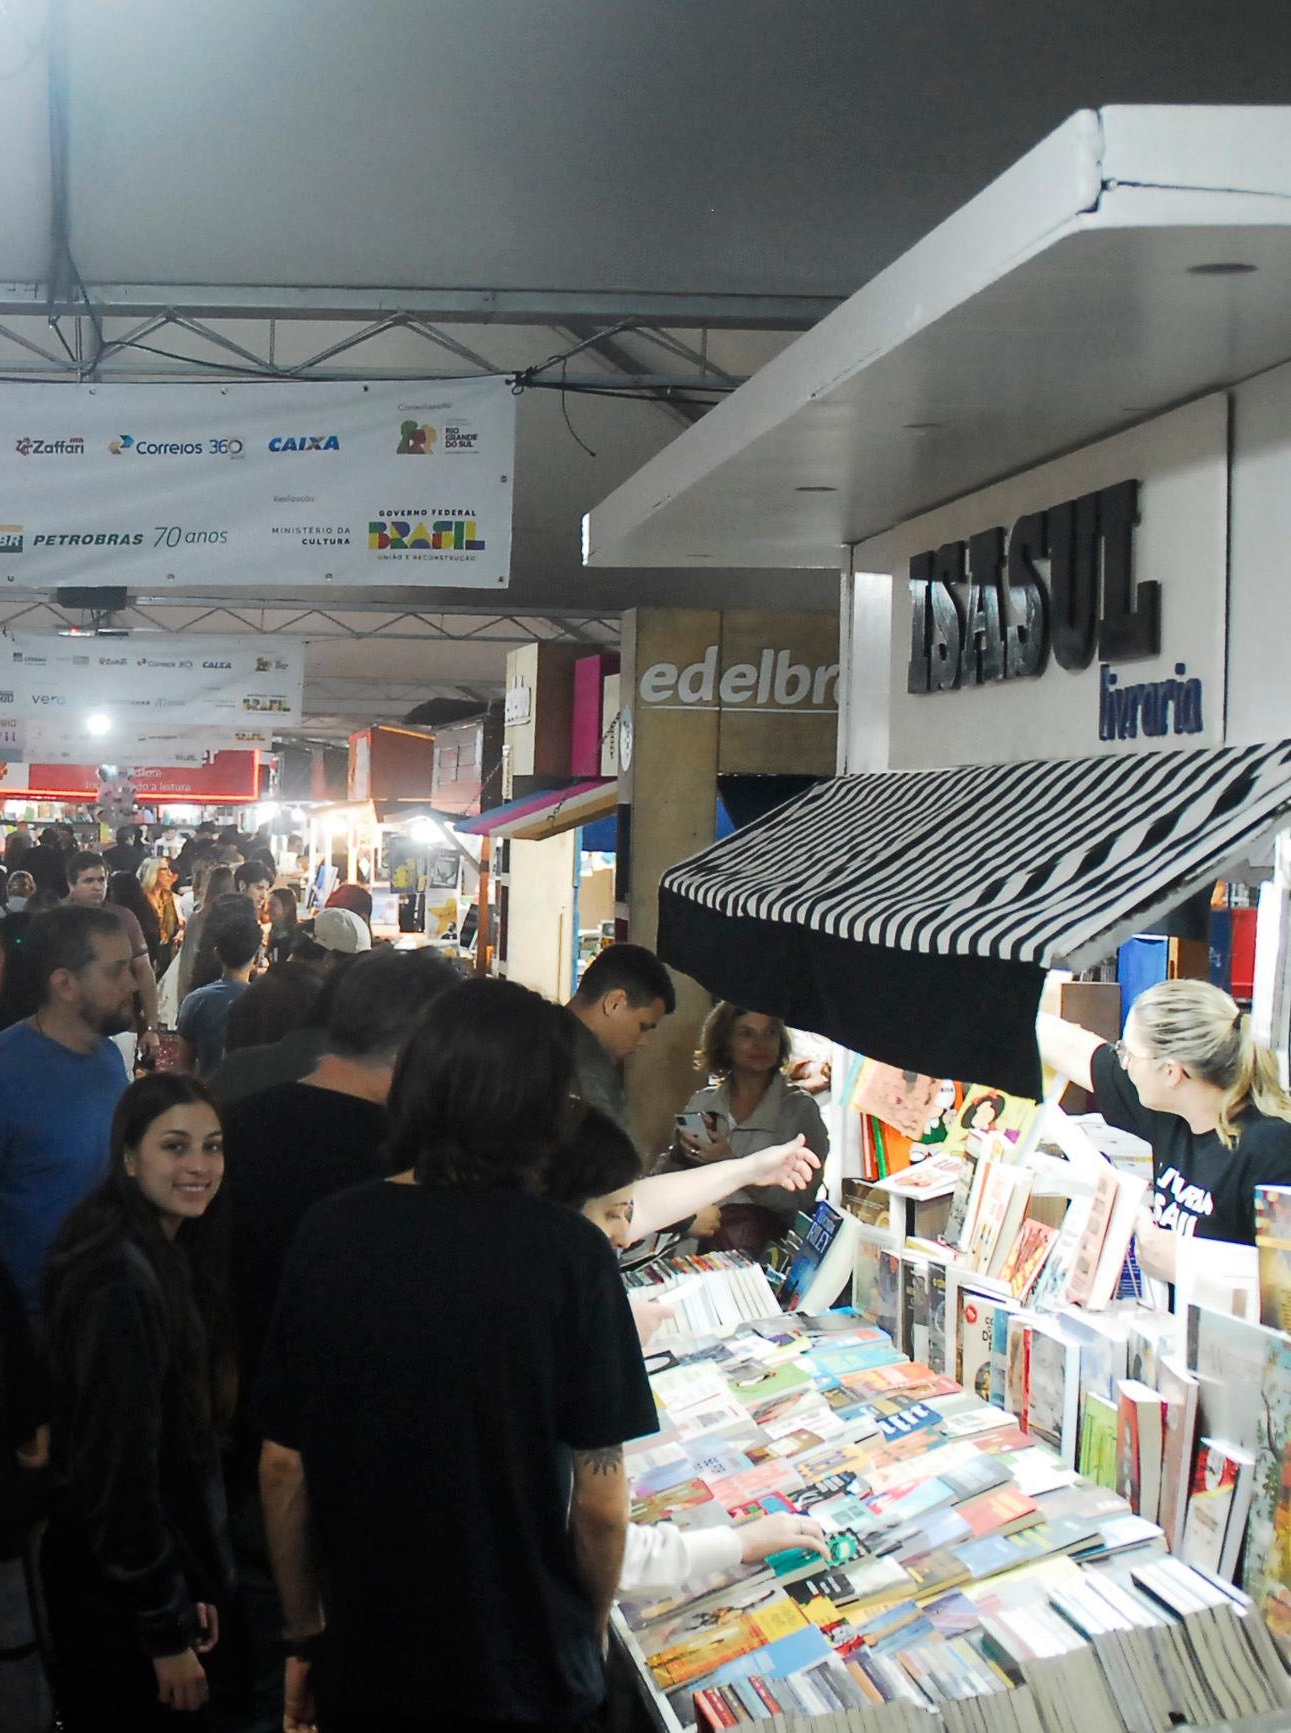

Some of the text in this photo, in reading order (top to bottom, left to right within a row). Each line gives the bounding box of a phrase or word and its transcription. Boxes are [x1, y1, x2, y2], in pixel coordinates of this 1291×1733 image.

[32, 439, 85, 455] Zaffari
[136, 441, 203, 455] Correios
[268, 436, 340, 452] CAIXA
[379, 509, 477, 518] GOVERNO FEDERAL
[33, 534, 144, 546] PETROBRAS
[153, 526, 182, 549] 70
[185, 529, 229, 545] anos
[272, 525, 351, 535] MINISTÉRIO DA
[368, 520, 486, 551] BRASIL
[301, 538, 351, 546] CULTURA
[908, 478, 1162, 694] ISASUL
[202, 660, 232, 670] CAIXA
[640, 646, 840, 705] edelbr
[32, 694, 66, 705] vero
